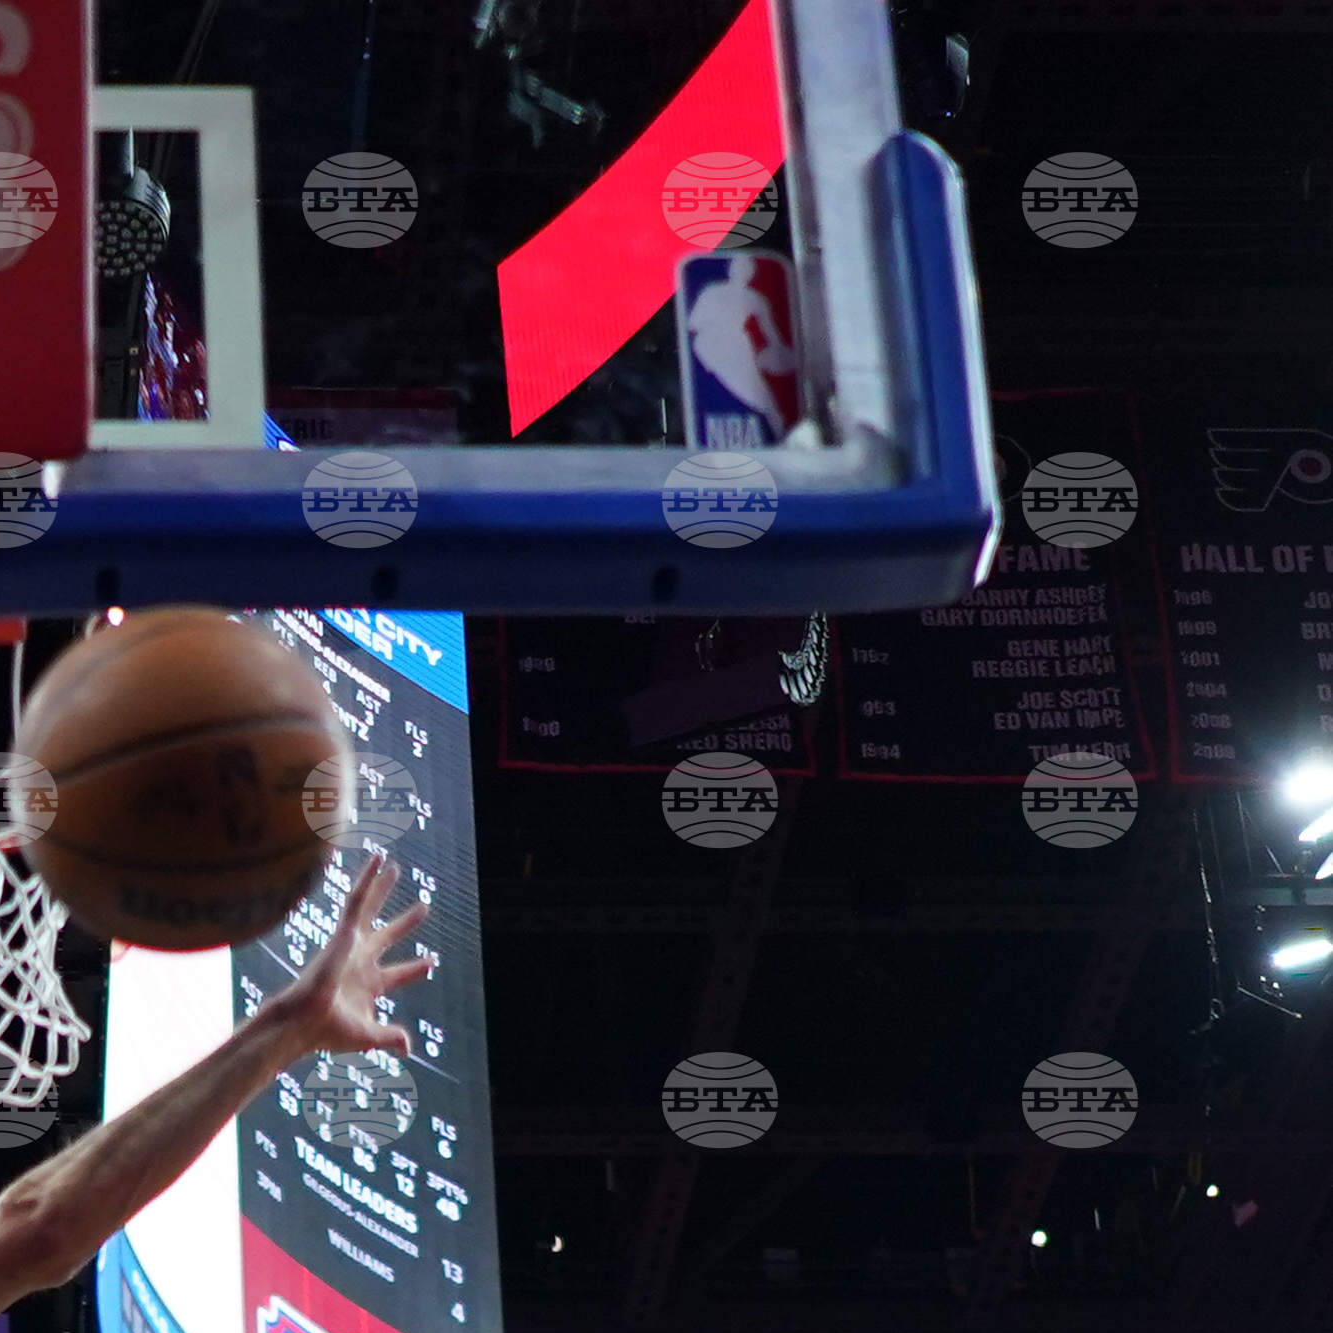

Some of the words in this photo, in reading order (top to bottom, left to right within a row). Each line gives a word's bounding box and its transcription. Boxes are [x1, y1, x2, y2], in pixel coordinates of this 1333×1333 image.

[998, 541, 1090, 573] FAME
[1180, 542, 1264, 574] HALL
[1271, 544, 1315, 573] OF
[376, 612, 443, 666] CITY
[971, 659, 1050, 679] REGGIE
[313, 655, 337, 683] REB
[356, 689, 381, 715] AST
[405, 720, 428, 745] FLS
[1018, 692, 1055, 711] JOE
[1059, 687, 1121, 709] SCOTT
[1026, 711, 1070, 730] VAN
[359, 763, 385, 787] AST
[408, 793, 432, 819] FLS
[412, 867, 436, 892] FLS
[418, 1019, 444, 1044] FLS
[391, 1092, 412, 1116] TO
[431, 1116, 457, 1141] FLS
[294, 1136, 342, 1187] TEAM
[343, 1172, 418, 1234] LEADERS
[390, 1151, 418, 1177] 3PT
[426, 1171, 469, 1205] 3PT%
[395, 1172, 415, 1198] 12
[254, 1129, 278, 1159] PTS
[441, 1258, 464, 1284] 13
[327, 1228, 395, 1283] WILLIAMS
